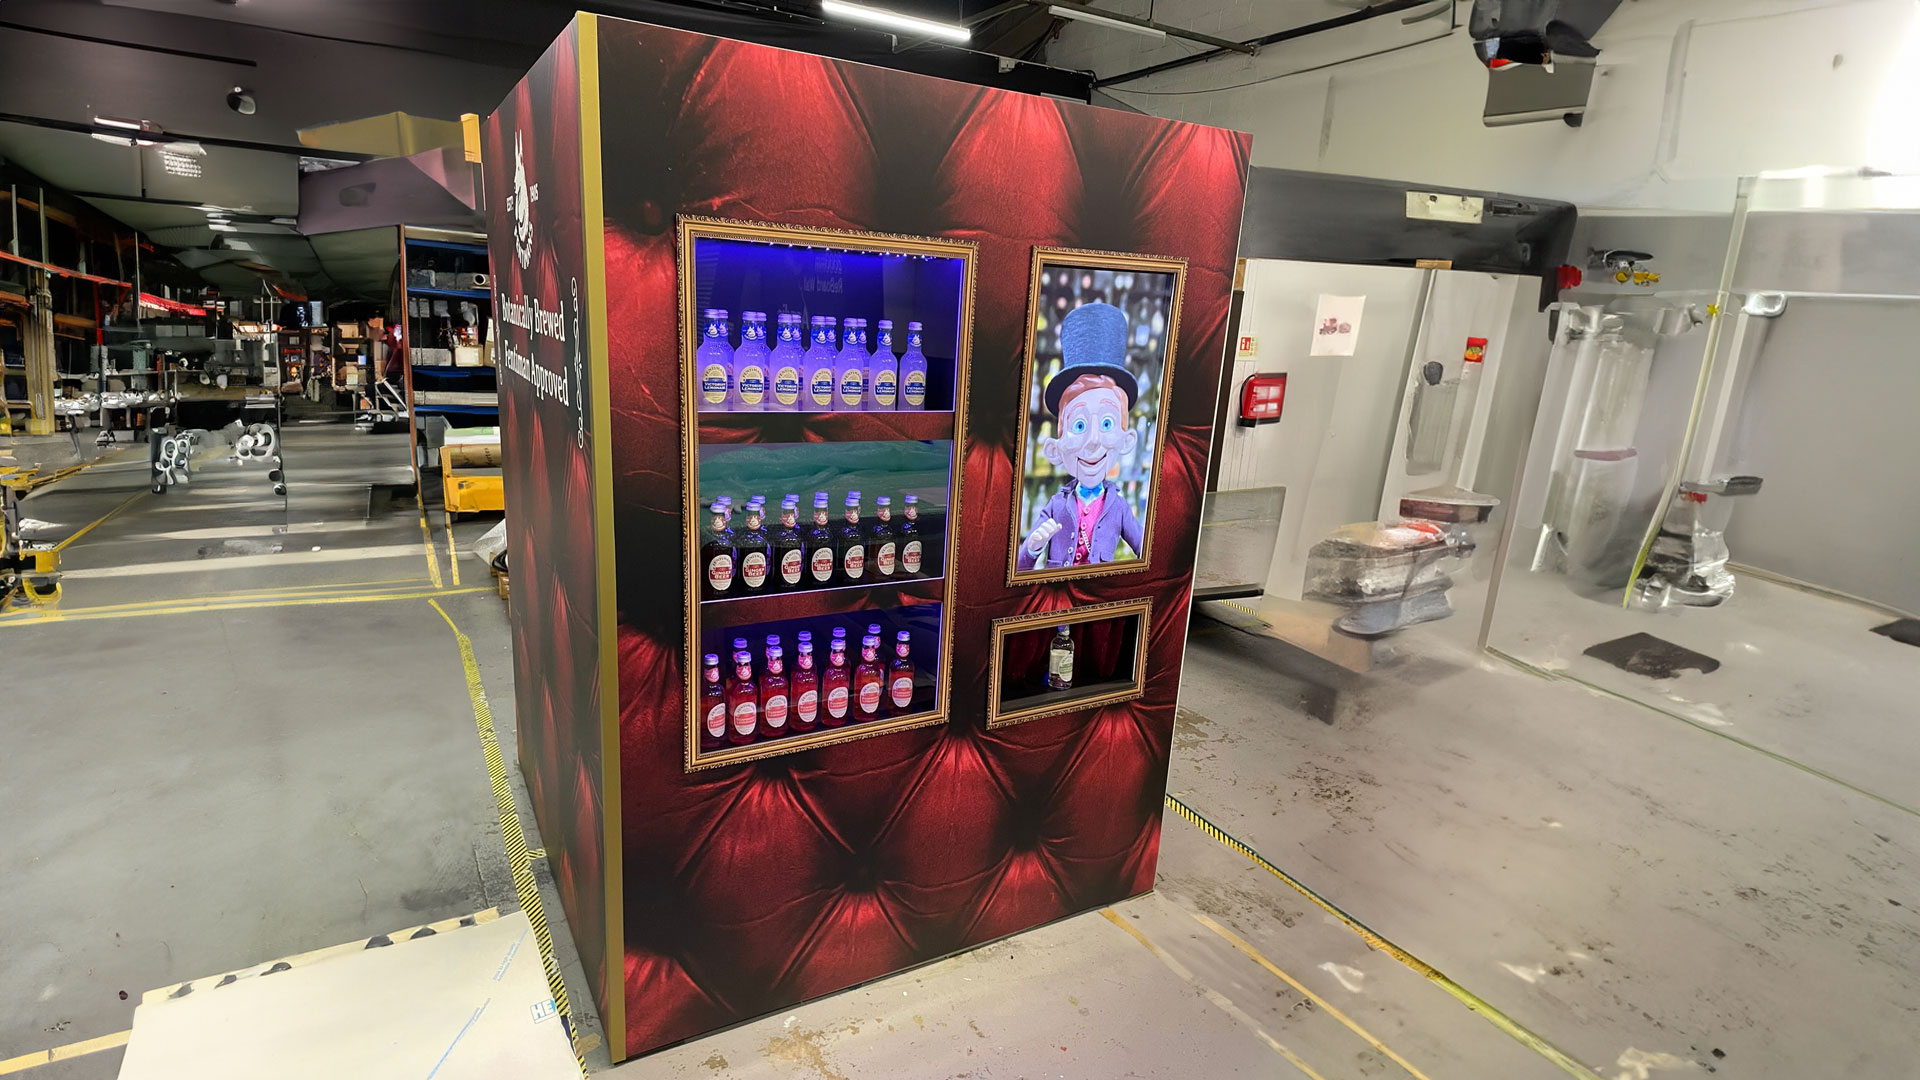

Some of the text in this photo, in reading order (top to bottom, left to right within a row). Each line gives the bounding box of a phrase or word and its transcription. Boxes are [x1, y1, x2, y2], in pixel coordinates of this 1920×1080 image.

[501, 292, 566, 342] Botanically Brewed
[504, 339, 570, 407] Fentiman Approved
